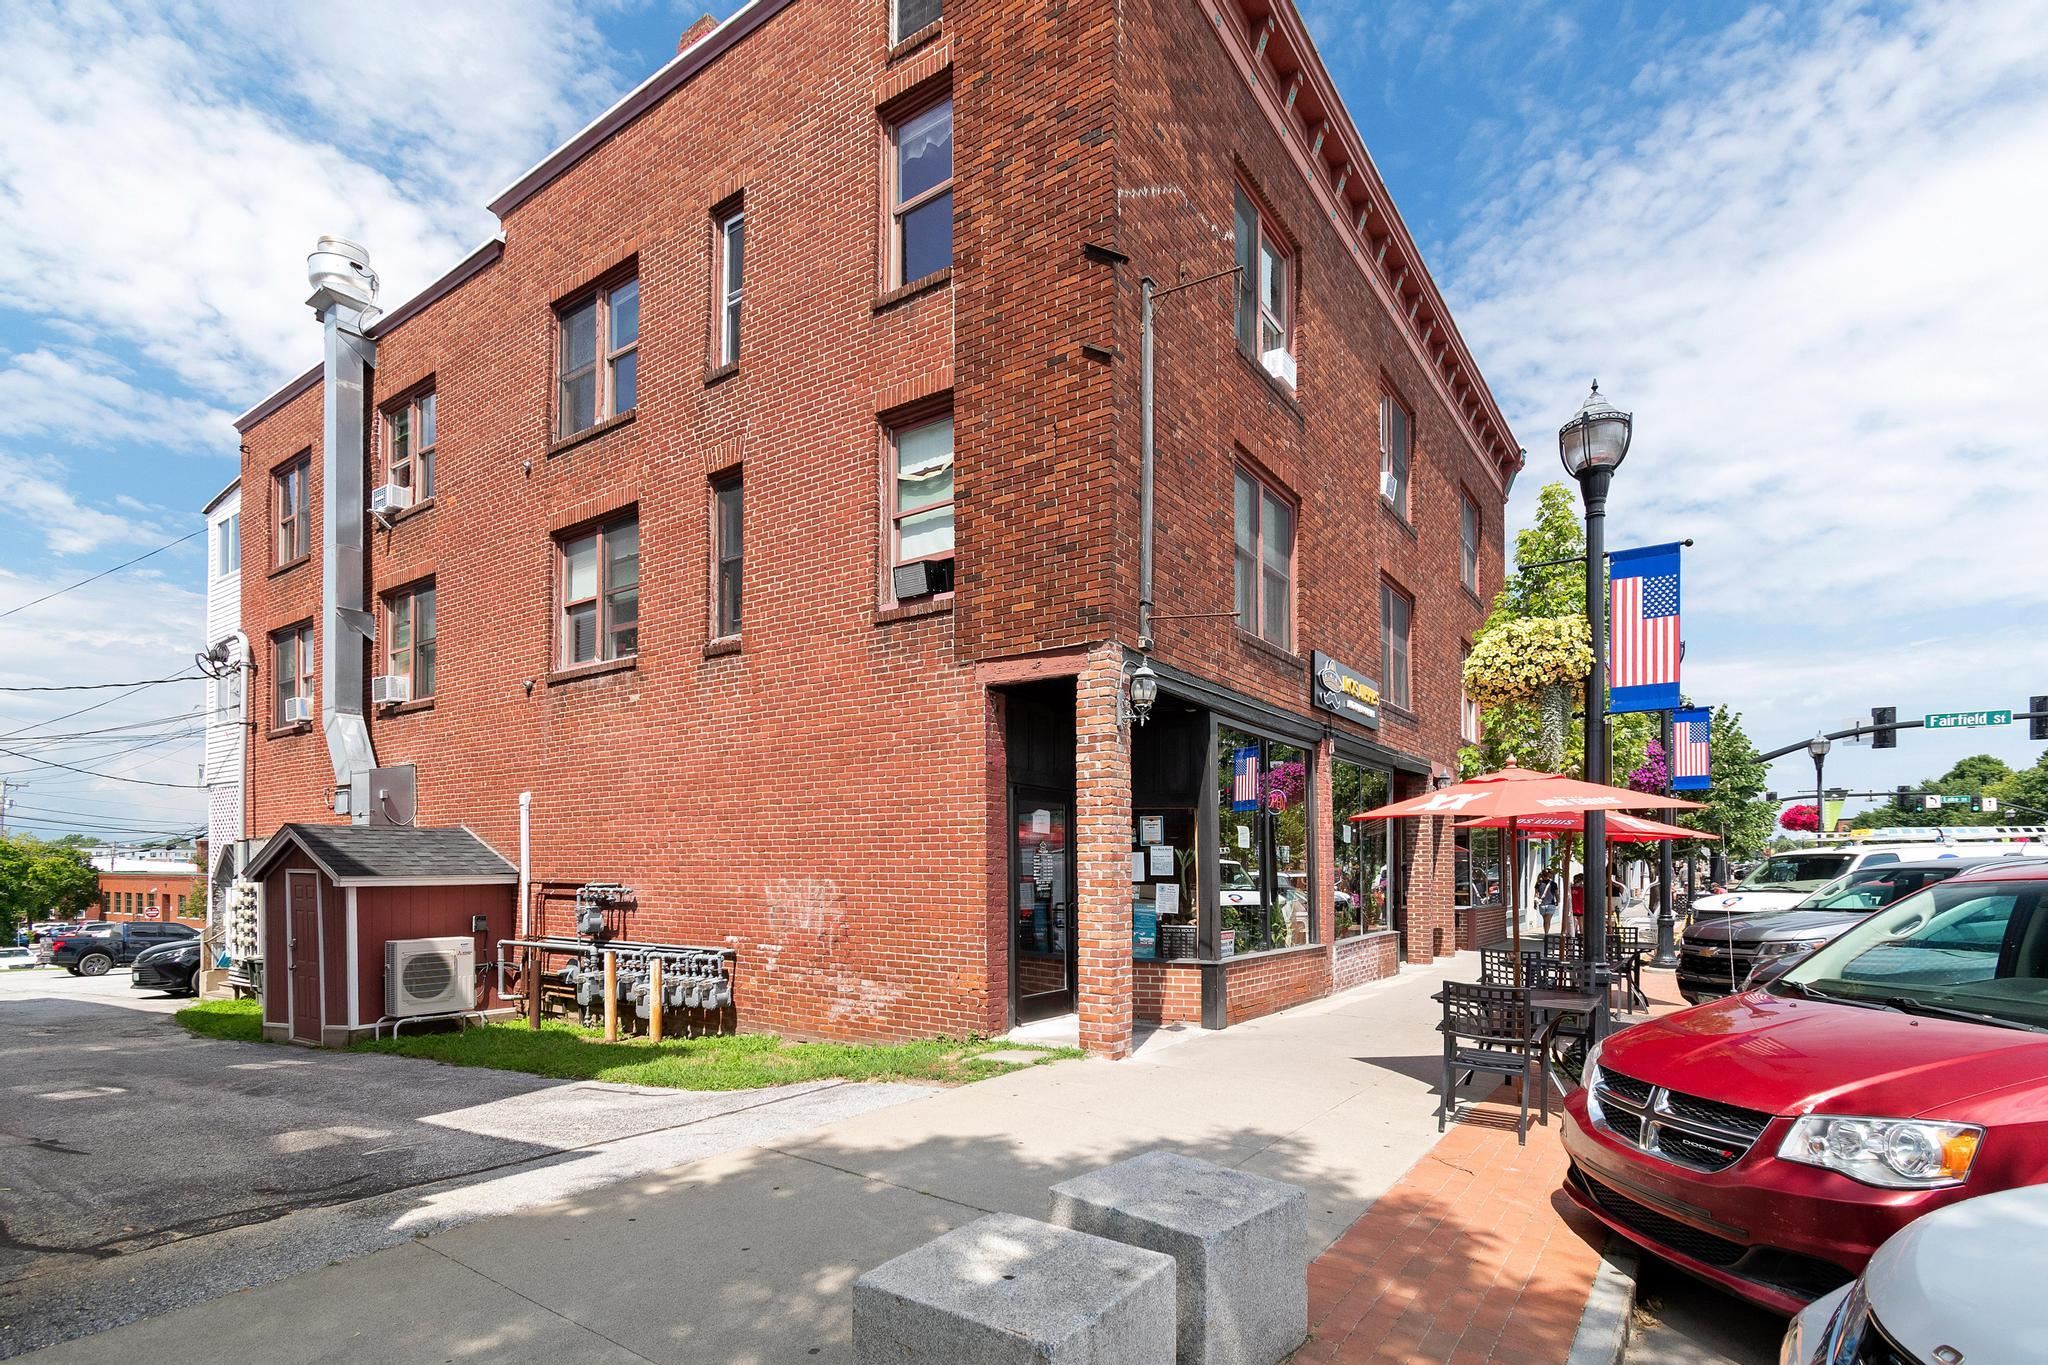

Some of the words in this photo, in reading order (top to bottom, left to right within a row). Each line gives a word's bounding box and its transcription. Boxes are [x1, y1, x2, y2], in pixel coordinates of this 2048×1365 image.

[1929, 712, 1988, 727] Fairfield
[1993, 713, 2007, 724] St
[1682, 1139, 1721, 1154] DODGE
